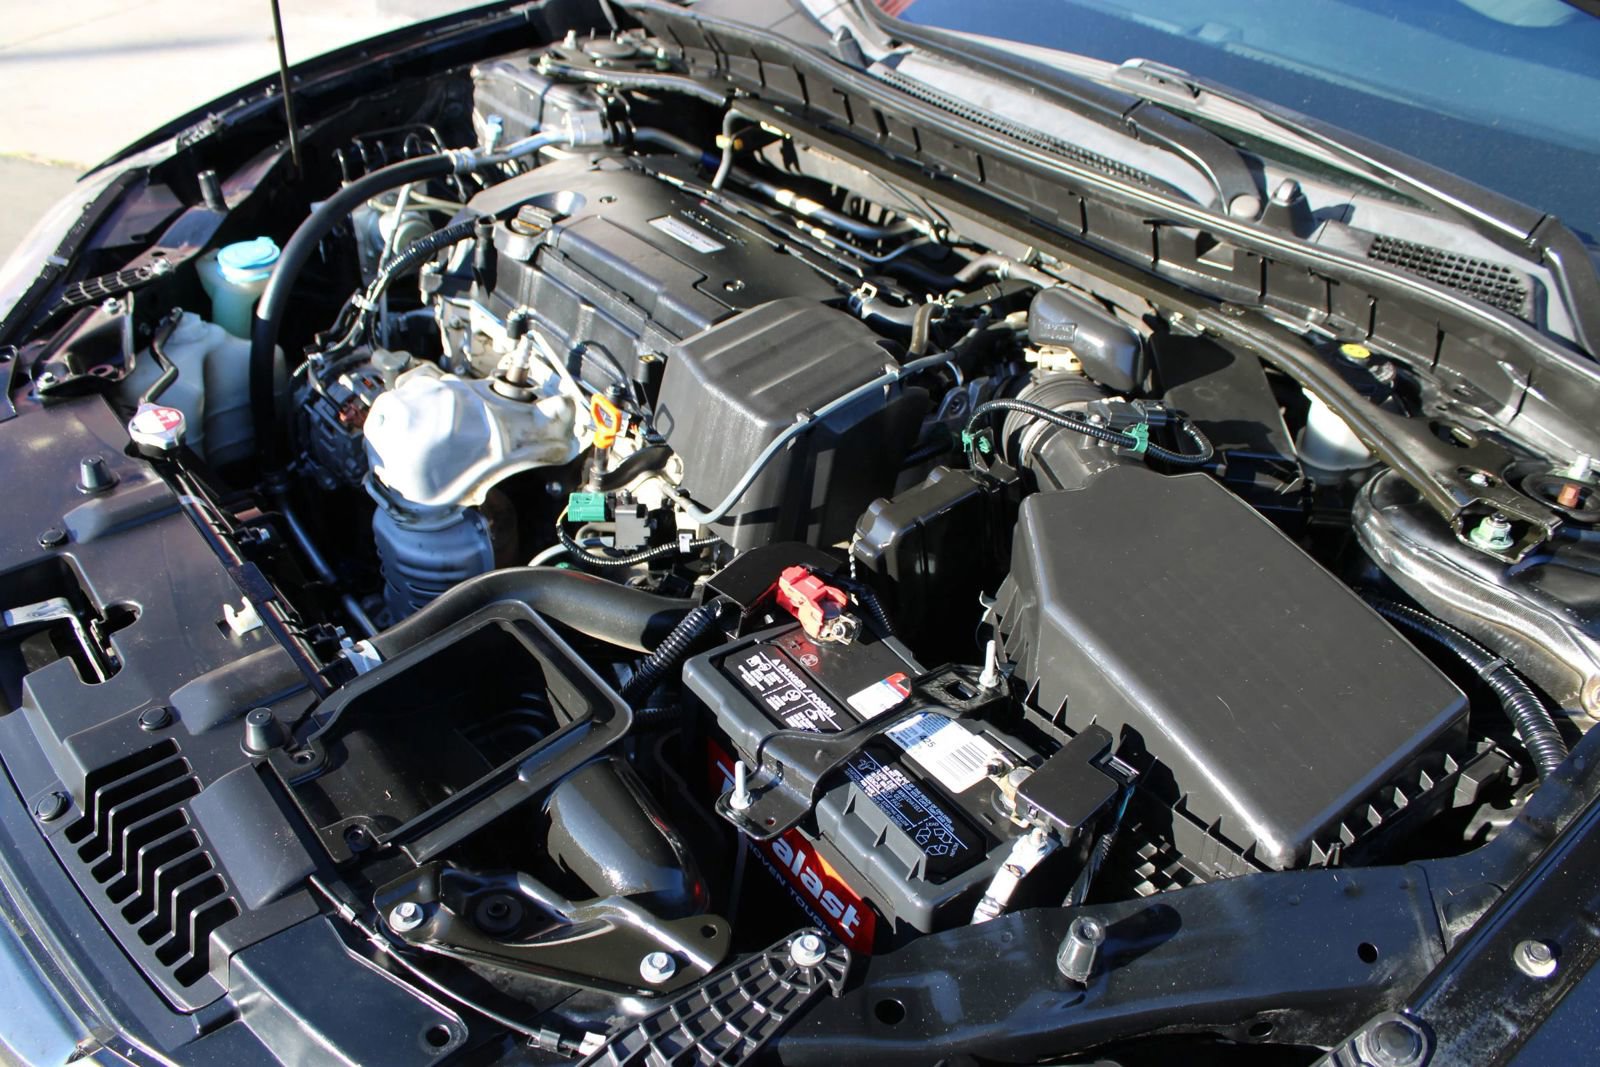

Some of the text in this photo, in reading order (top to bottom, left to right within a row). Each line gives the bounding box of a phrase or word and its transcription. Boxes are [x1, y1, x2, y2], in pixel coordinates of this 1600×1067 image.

[778, 664, 807, 689] DANGER
[808, 693, 837, 717] POISON
[919, 735, 935, 748] 425
[893, 794, 903, 802] GET
[771, 838, 861, 938] alast
[789, 887, 831, 936] TOUGH
